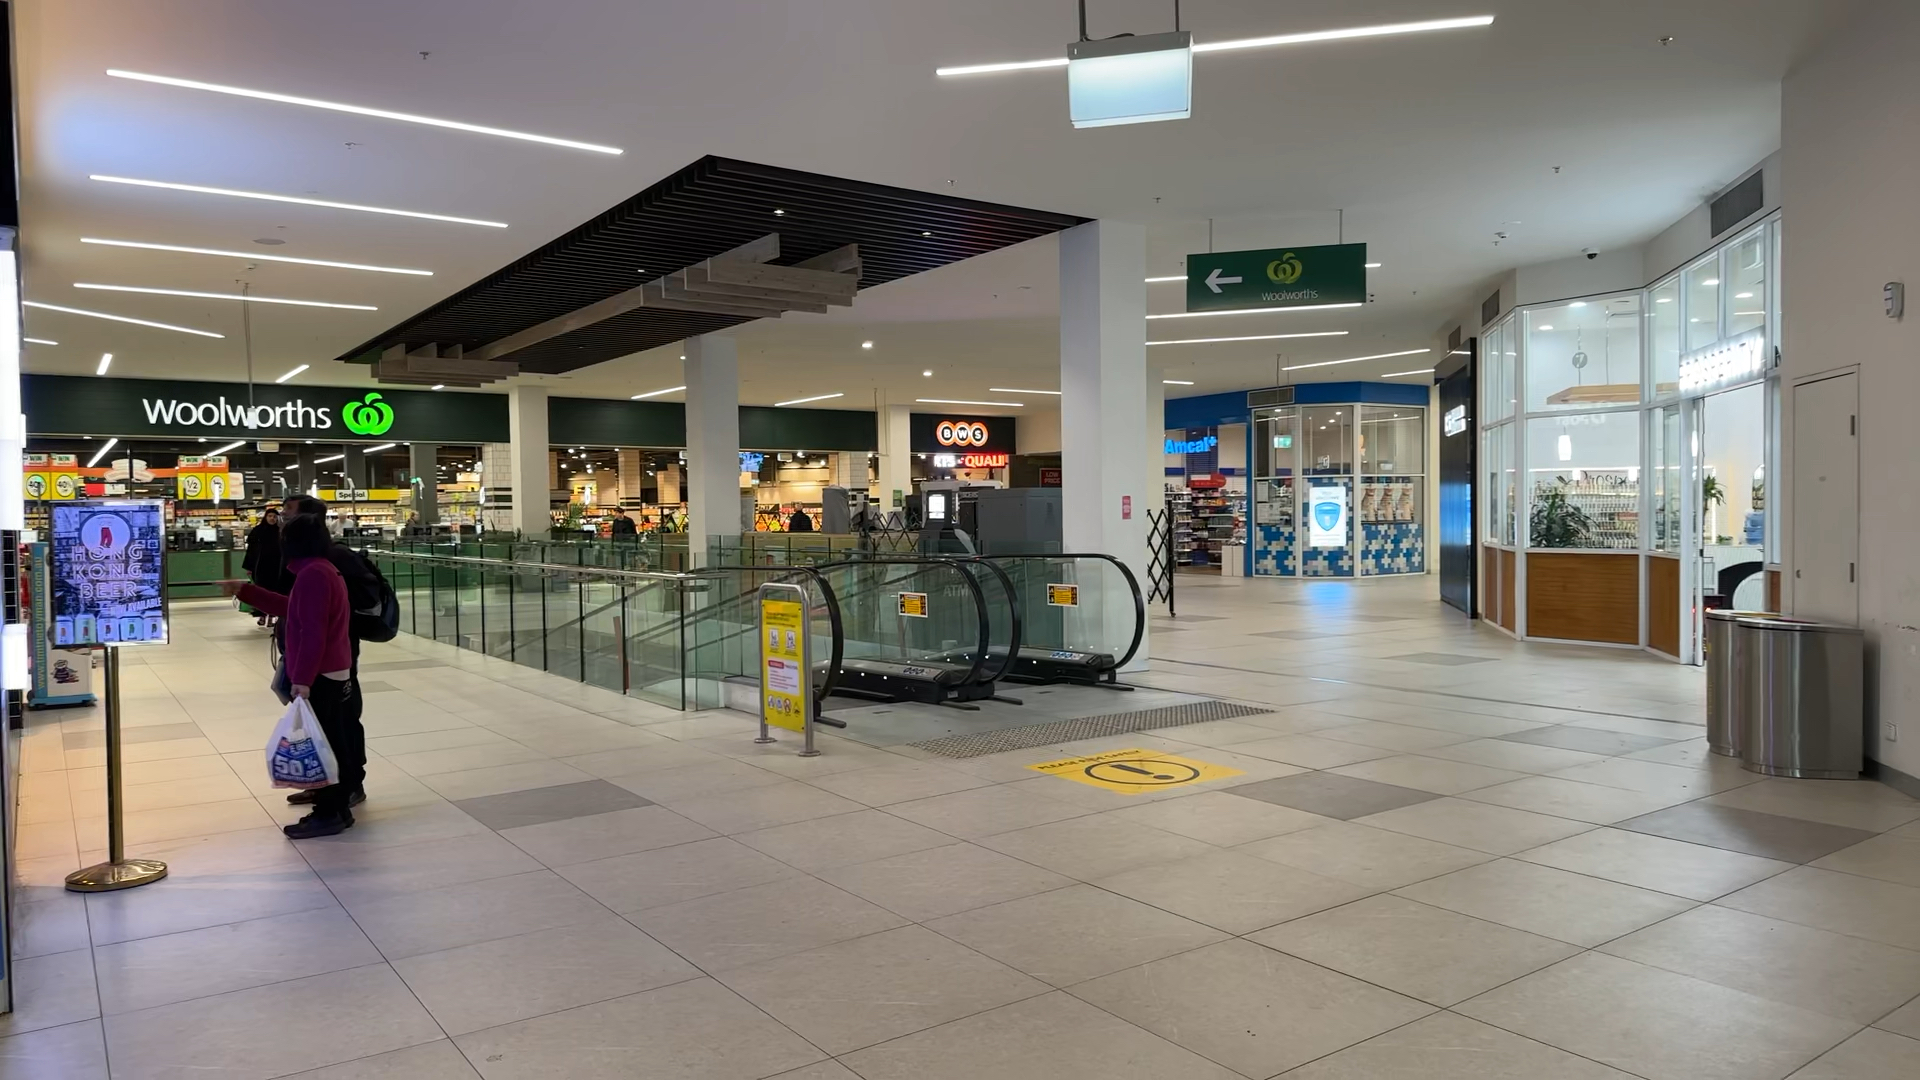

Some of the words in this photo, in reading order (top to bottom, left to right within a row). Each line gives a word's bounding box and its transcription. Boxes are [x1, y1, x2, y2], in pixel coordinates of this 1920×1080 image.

[1261, 288, 1319, 302] Woolworths
[142, 396, 332, 429] Woolworths
[71, 544, 143, 562] HONG
[72, 562, 143, 580] KONG
[79, 580, 137, 599] BEER
